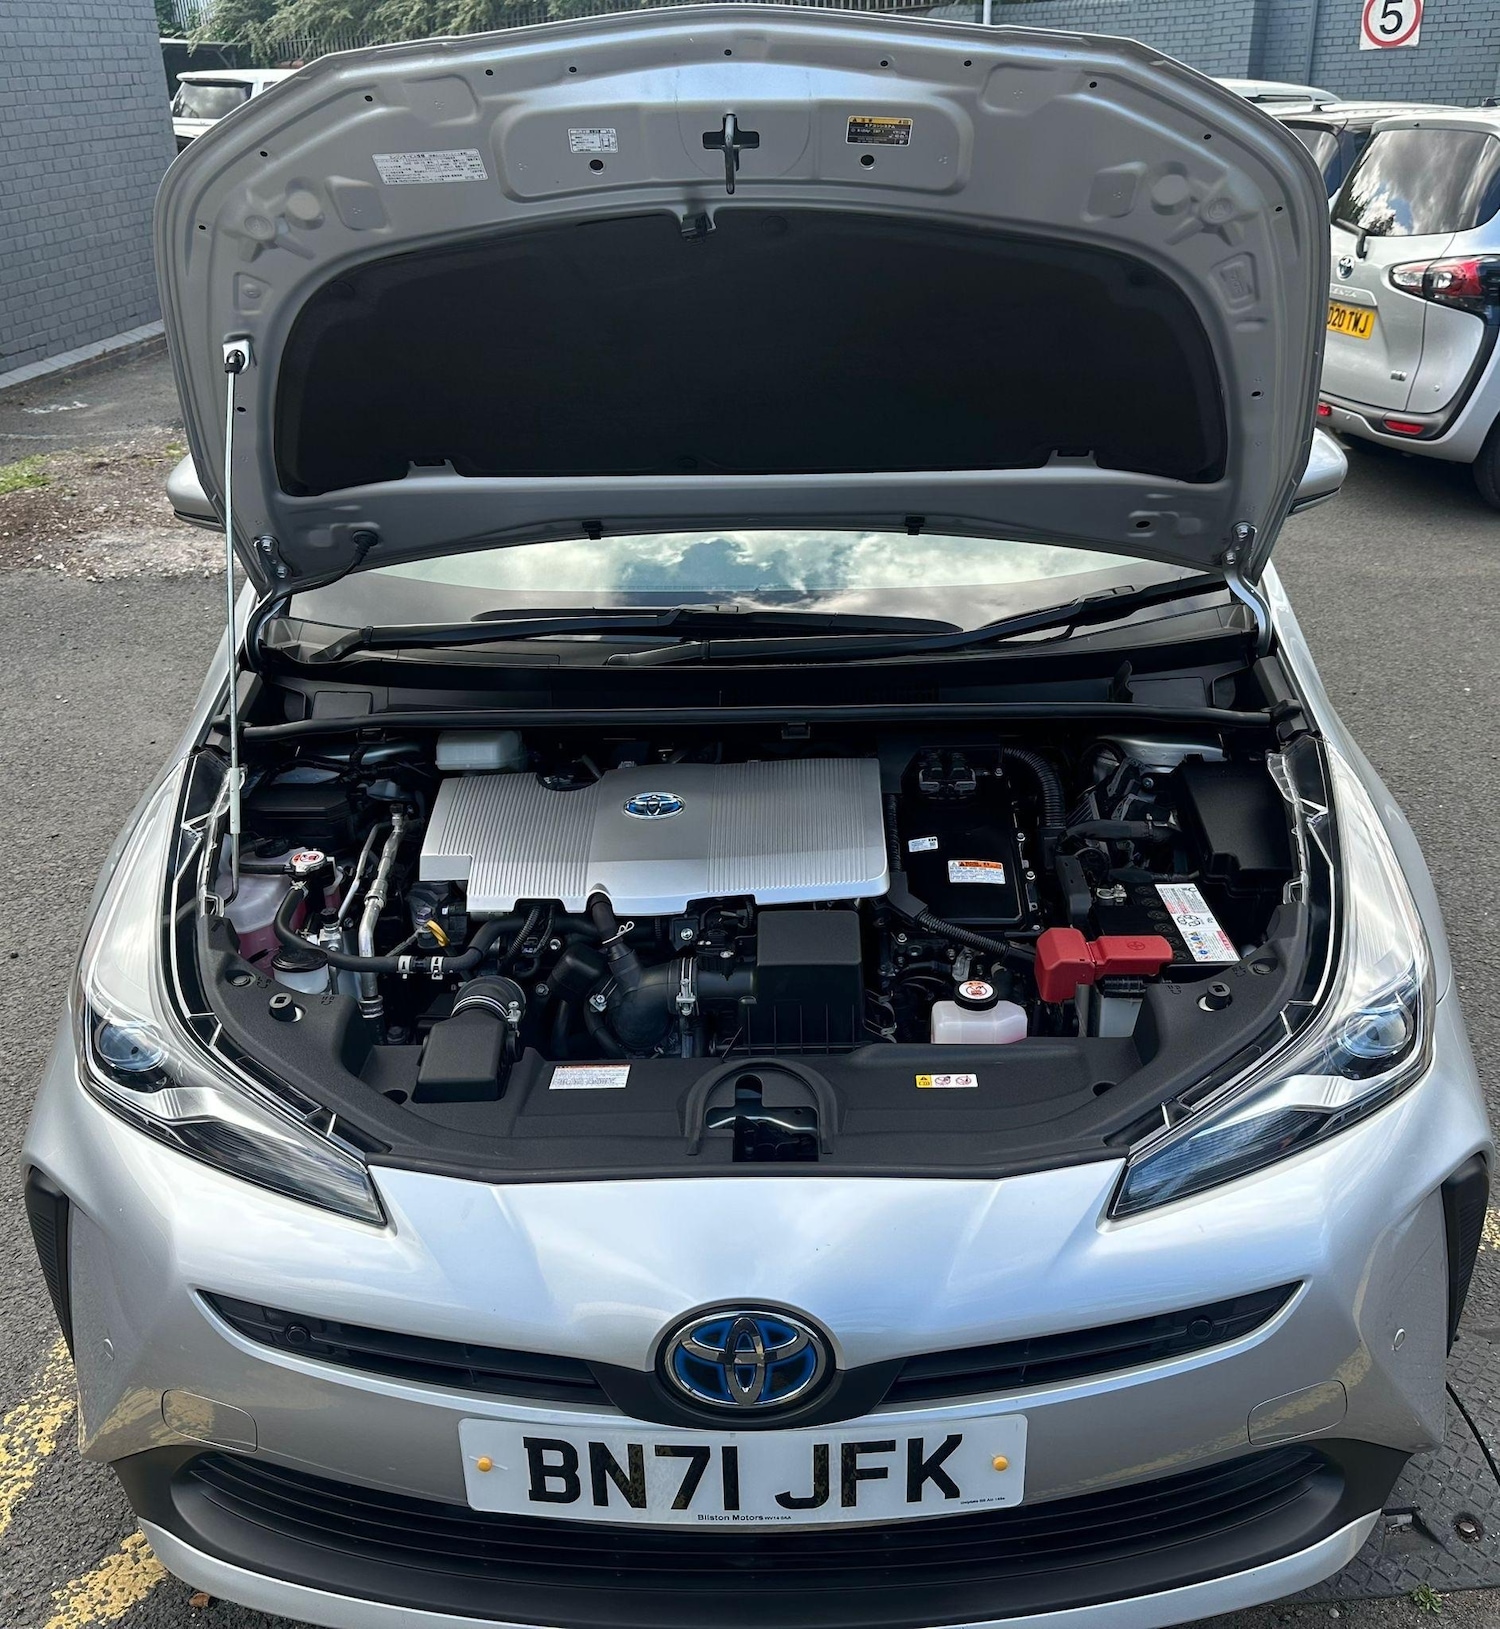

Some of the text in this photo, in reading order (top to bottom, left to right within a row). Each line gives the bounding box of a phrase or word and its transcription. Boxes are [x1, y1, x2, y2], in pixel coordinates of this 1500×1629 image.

[1379, 0, 1403, 35] 5
[1346, 311, 1370, 334] TWJ
[523, 1433, 963, 1511] BN71 JFK
[697, 1513, 730, 1521] Bilston
[732, 1513, 764, 1521] Motors
